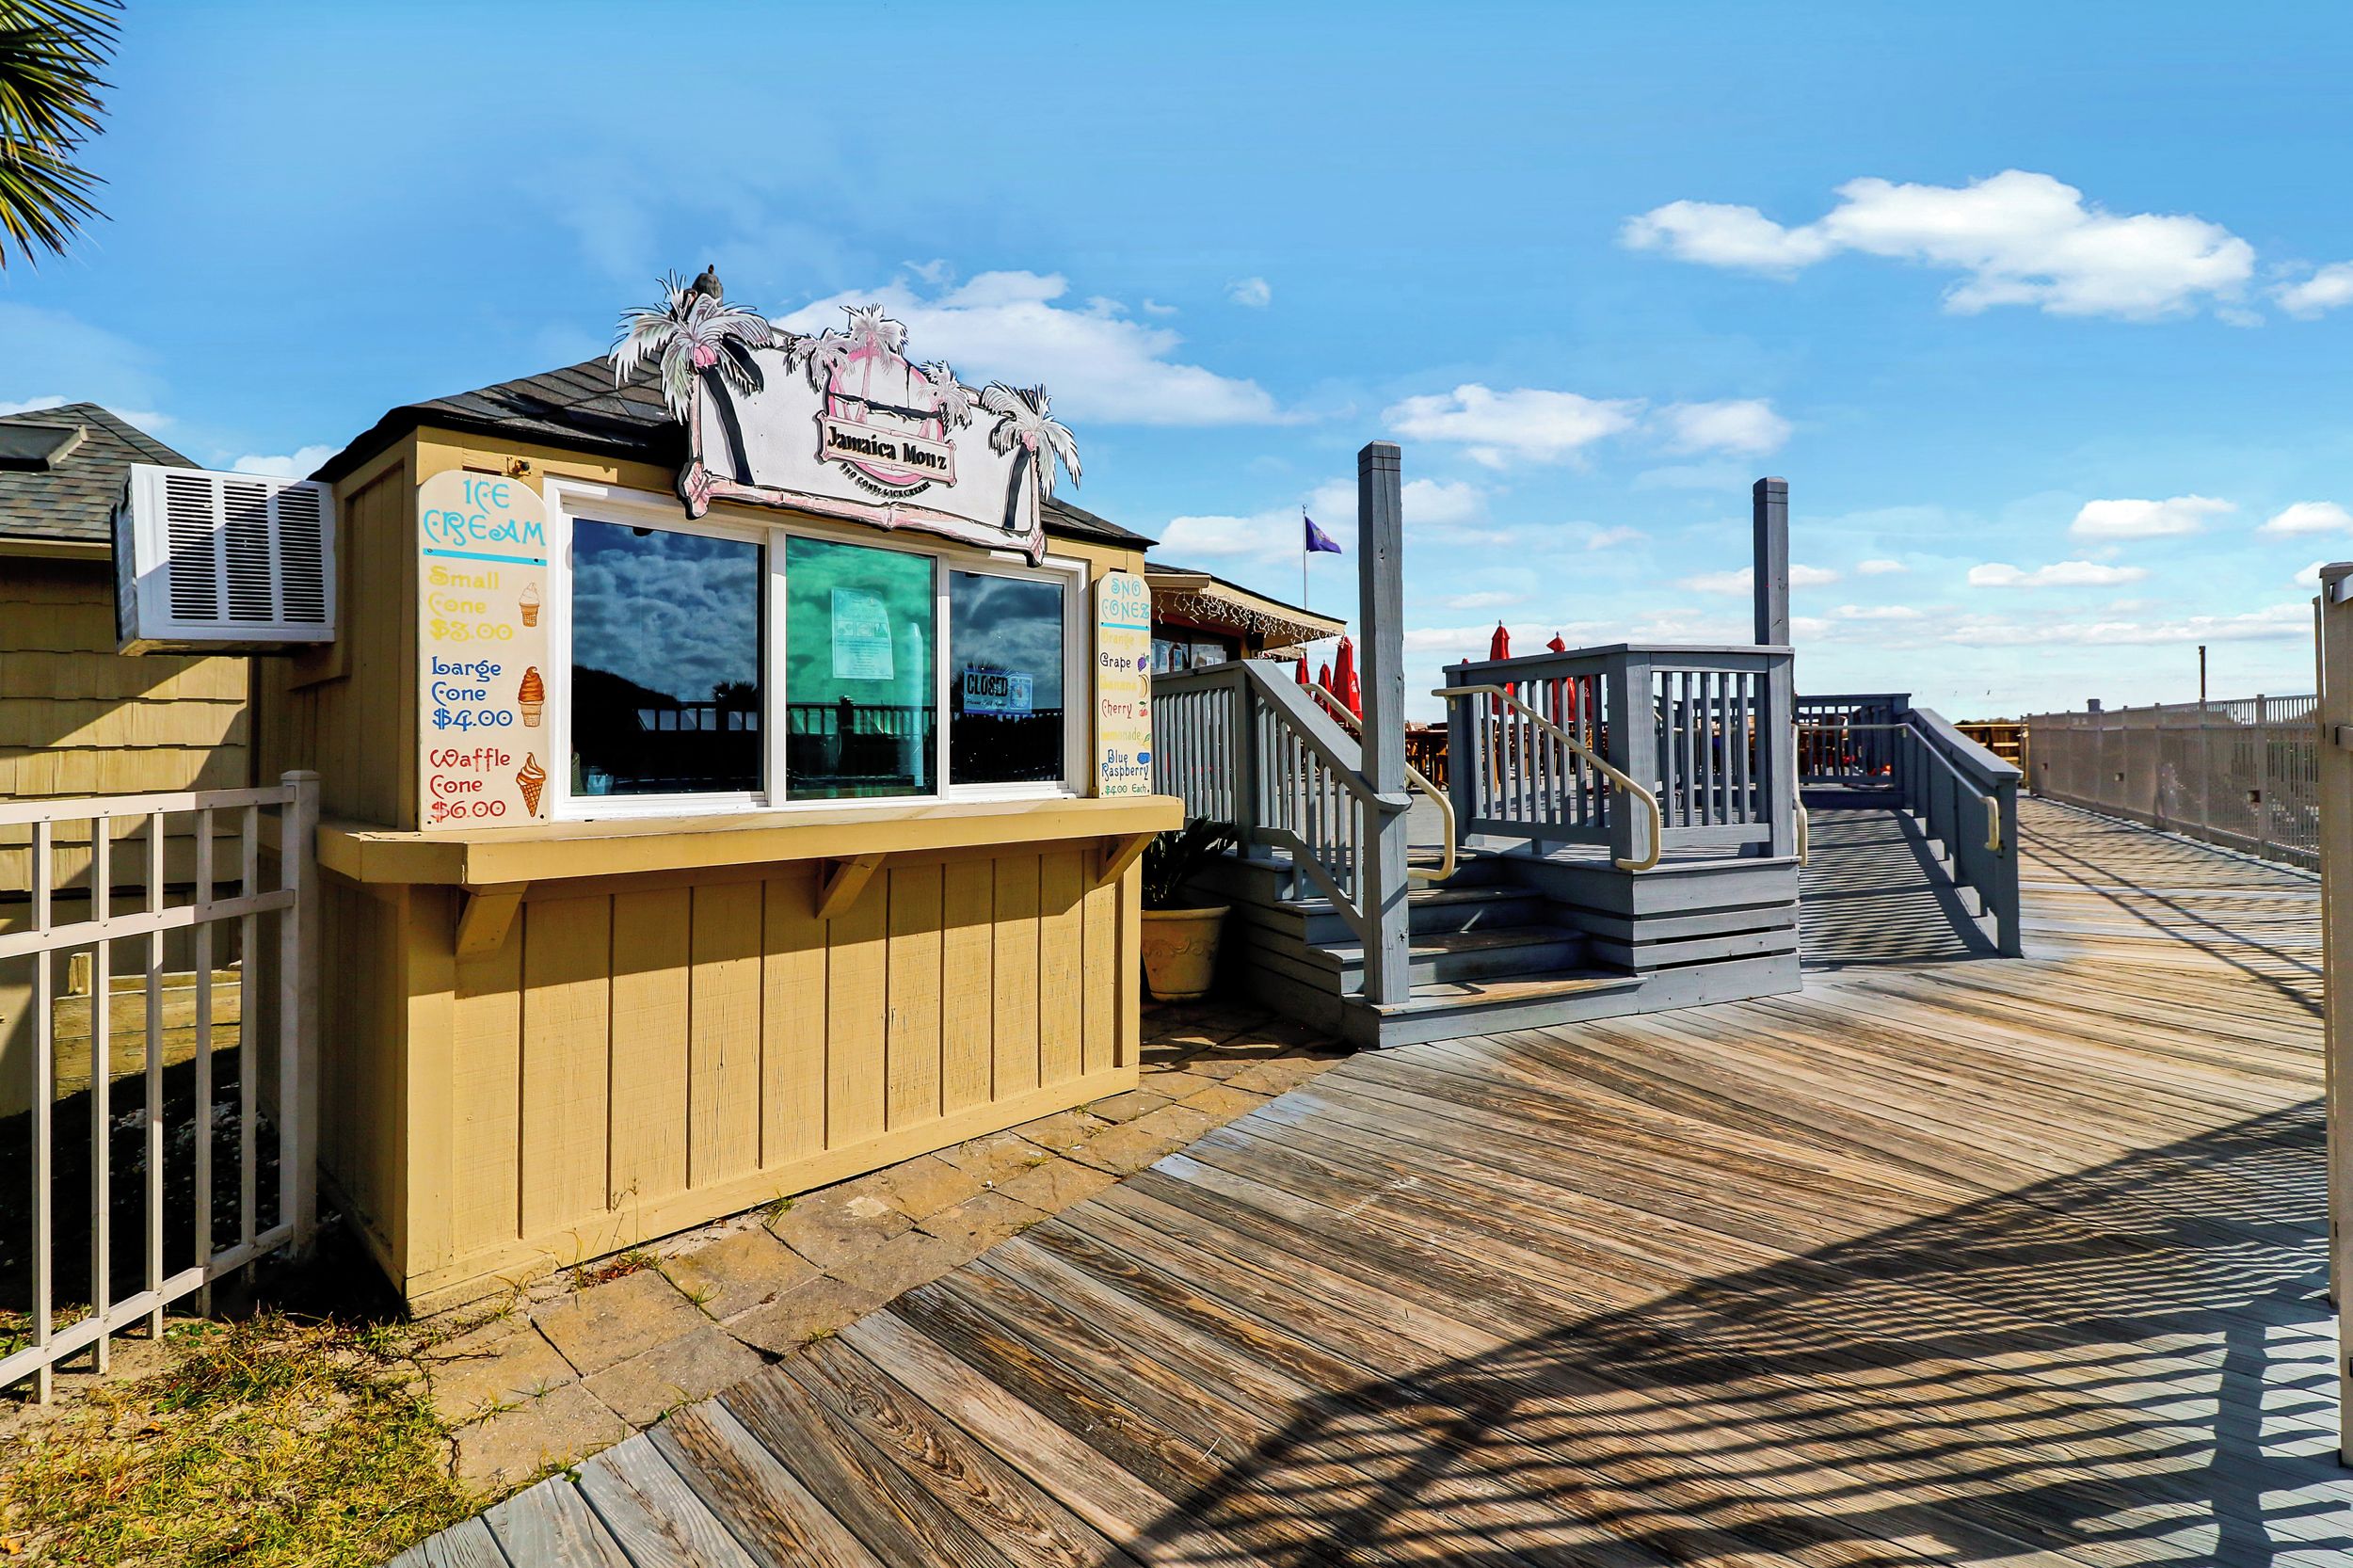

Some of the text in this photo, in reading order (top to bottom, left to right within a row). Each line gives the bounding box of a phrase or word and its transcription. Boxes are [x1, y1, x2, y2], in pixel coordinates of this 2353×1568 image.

[827, 425, 947, 471] Jamaica Monz
[840, 461, 857, 478] SNO
[889, 488, 904, 498] ICE
[463, 479, 510, 514] ICE
[423, 508, 546, 547] CREAM
[428, 565, 500, 589] Small
[1111, 577, 1141, 600] SNO
[428, 591, 487, 618] Cone
[1101, 598, 1150, 621] CONEZ
[429, 617, 514, 643] $3.00
[1100, 630, 1135, 649] Orange
[431, 655, 502, 682] Large
[1099, 651, 1131, 672] Grape
[431, 681, 487, 708] Cone
[967, 674, 1009, 697] CLOSED
[432, 707, 514, 731] $4.00
[1101, 698, 1132, 719] Cherry
[429, 747, 511, 772] Waffle
[1107, 748, 1128, 763] Blue
[1101, 762, 1149, 782] Raspberry
[429, 775, 484, 801] Cone
[1131, 783, 1147, 794] Each
[430, 800, 506, 823] $6.00
